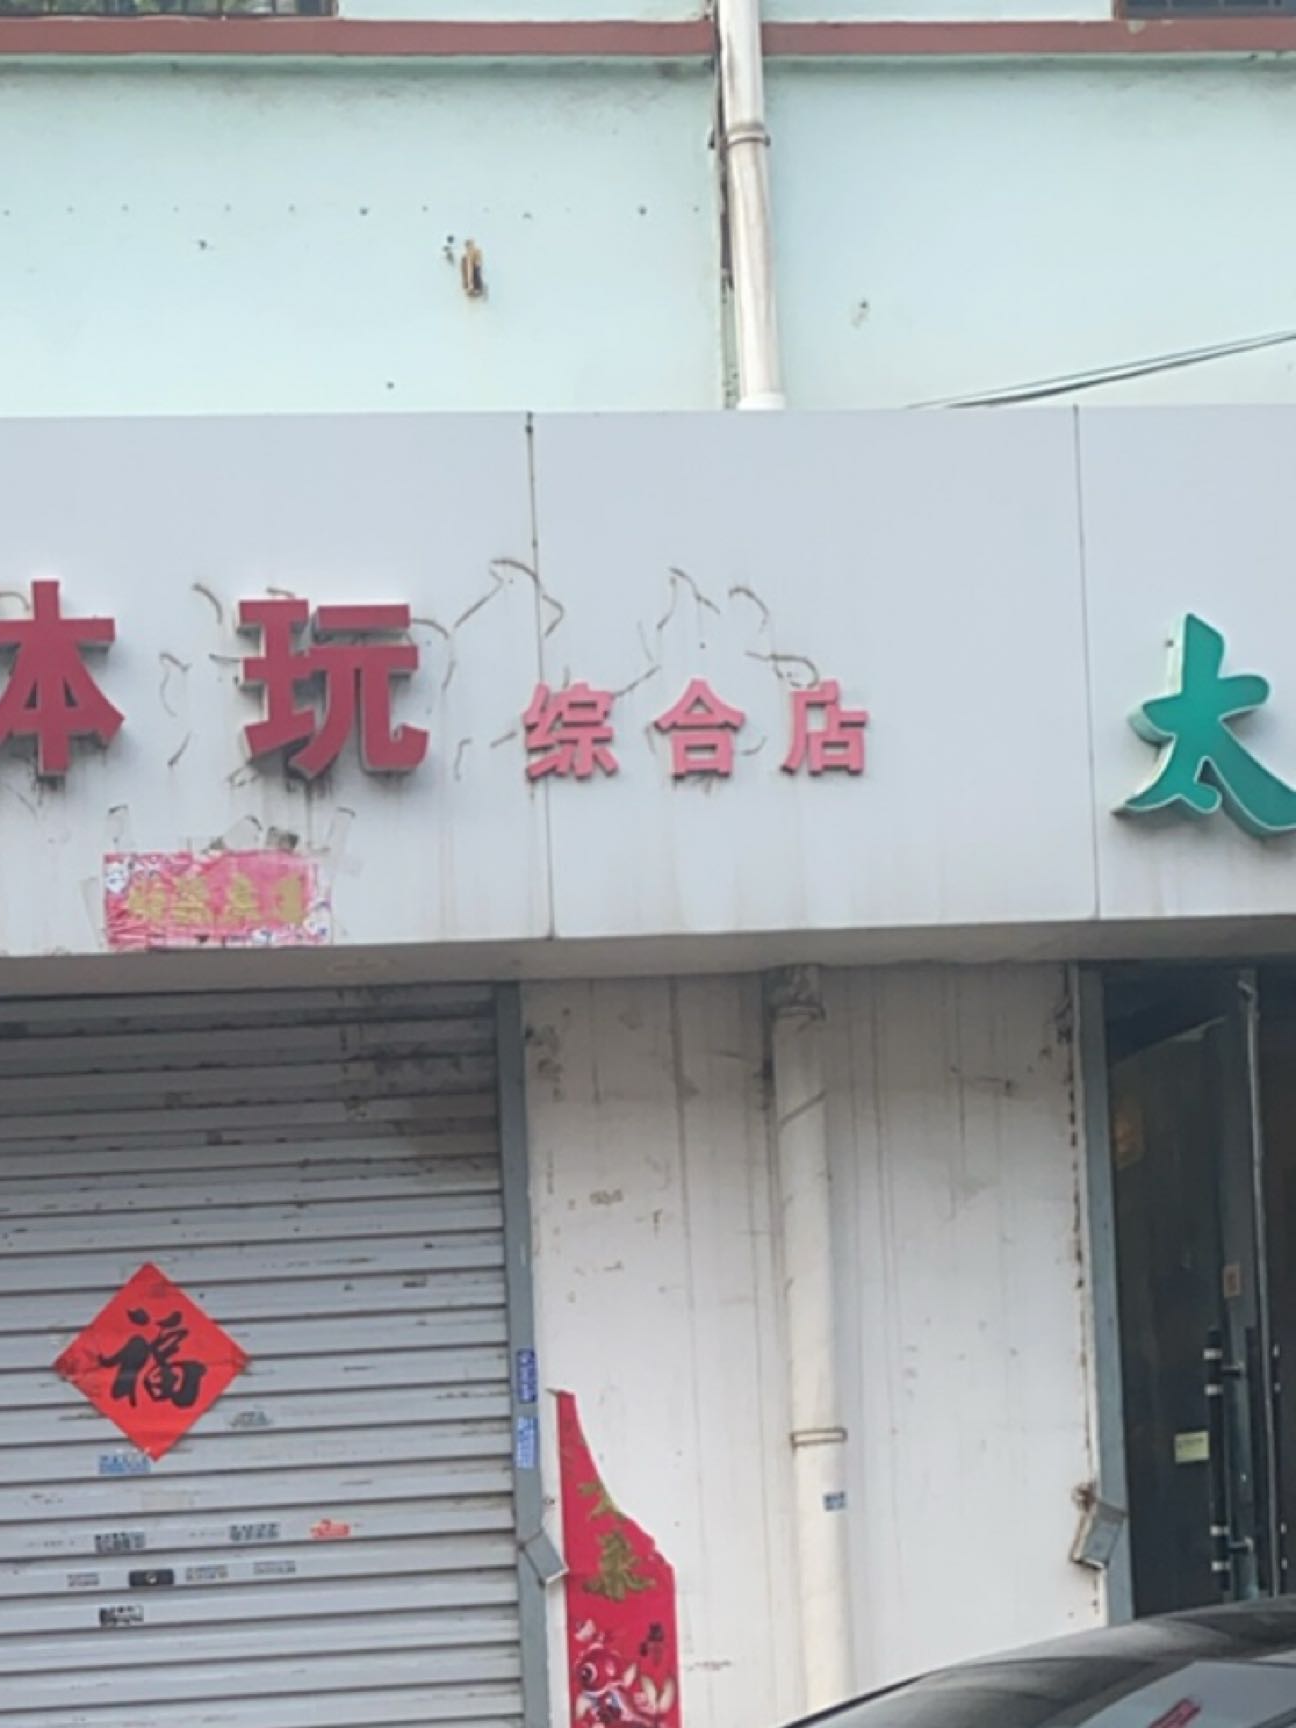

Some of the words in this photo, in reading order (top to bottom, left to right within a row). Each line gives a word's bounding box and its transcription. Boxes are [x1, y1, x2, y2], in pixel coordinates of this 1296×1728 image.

[521, 678, 869, 780] 综合店
[97, 1307, 207, 1410] 福
